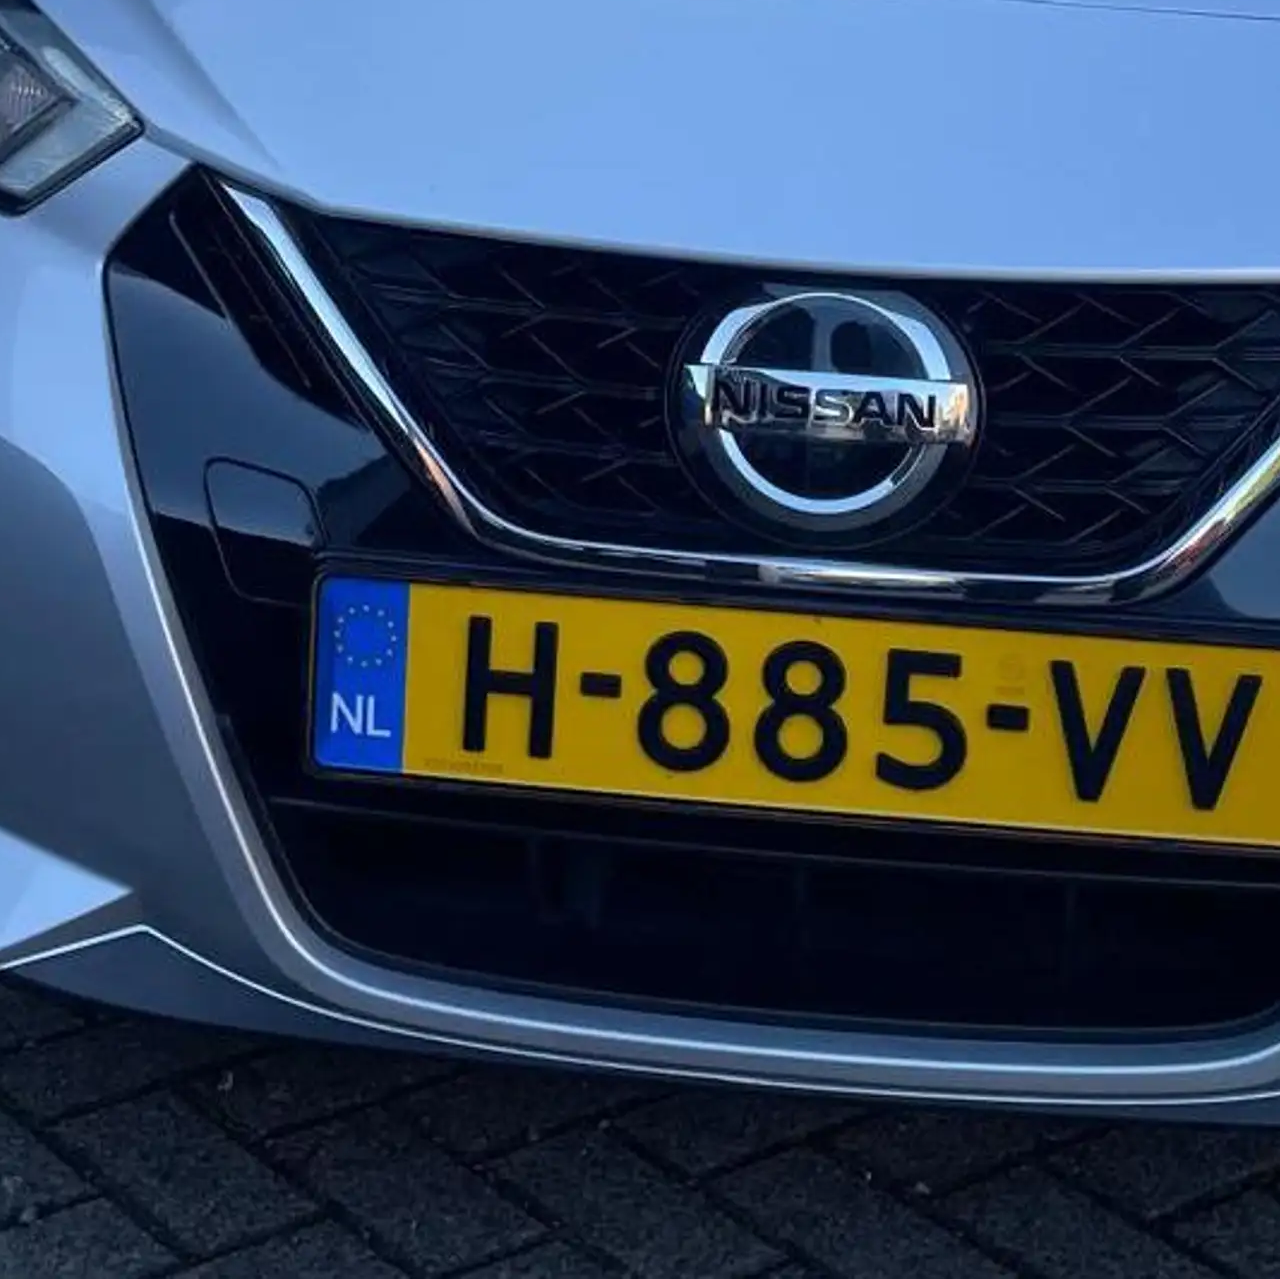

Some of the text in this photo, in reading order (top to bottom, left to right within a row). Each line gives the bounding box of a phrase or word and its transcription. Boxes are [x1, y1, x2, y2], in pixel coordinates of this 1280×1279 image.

[710, 373, 939, 430] NISSAN
[330, 690, 392, 738] NL
[461, 615, 1263, 812] H-885-VV
